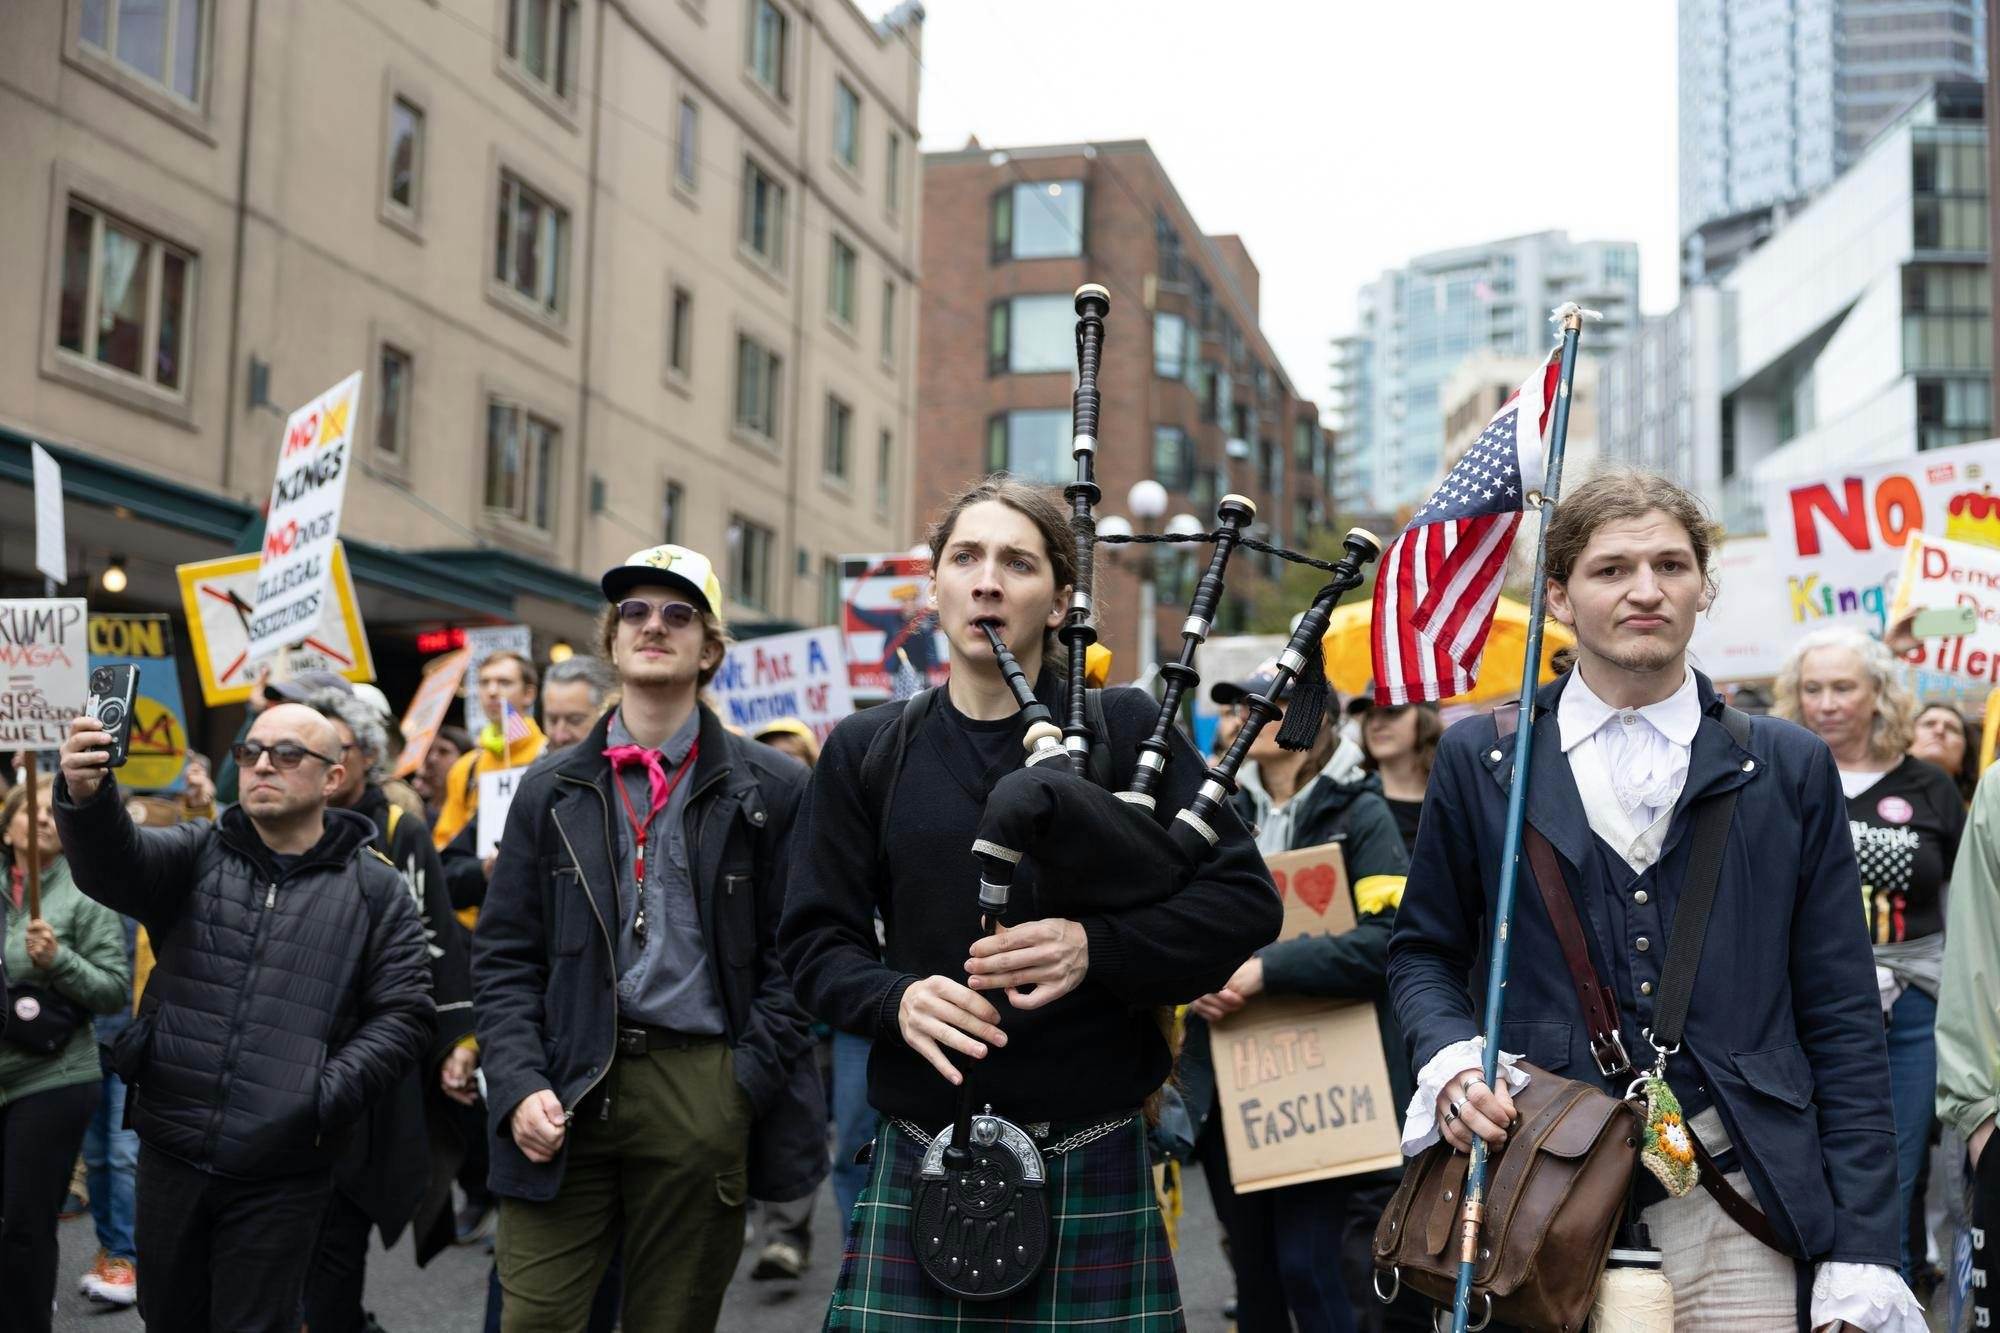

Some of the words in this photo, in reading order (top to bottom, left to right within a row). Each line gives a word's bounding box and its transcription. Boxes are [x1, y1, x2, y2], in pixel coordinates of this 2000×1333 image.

[285, 411, 318, 458] NO
[274, 444, 344, 509] KINGS
[263, 519, 297, 565] NO
[1789, 473, 1924, 557] NO
[808, 640, 828, 674] A
[729, 690, 797, 725] NATION
[1230, 1028, 1325, 1091] HATE
[1240, 1085, 1376, 1149] FASCISM
